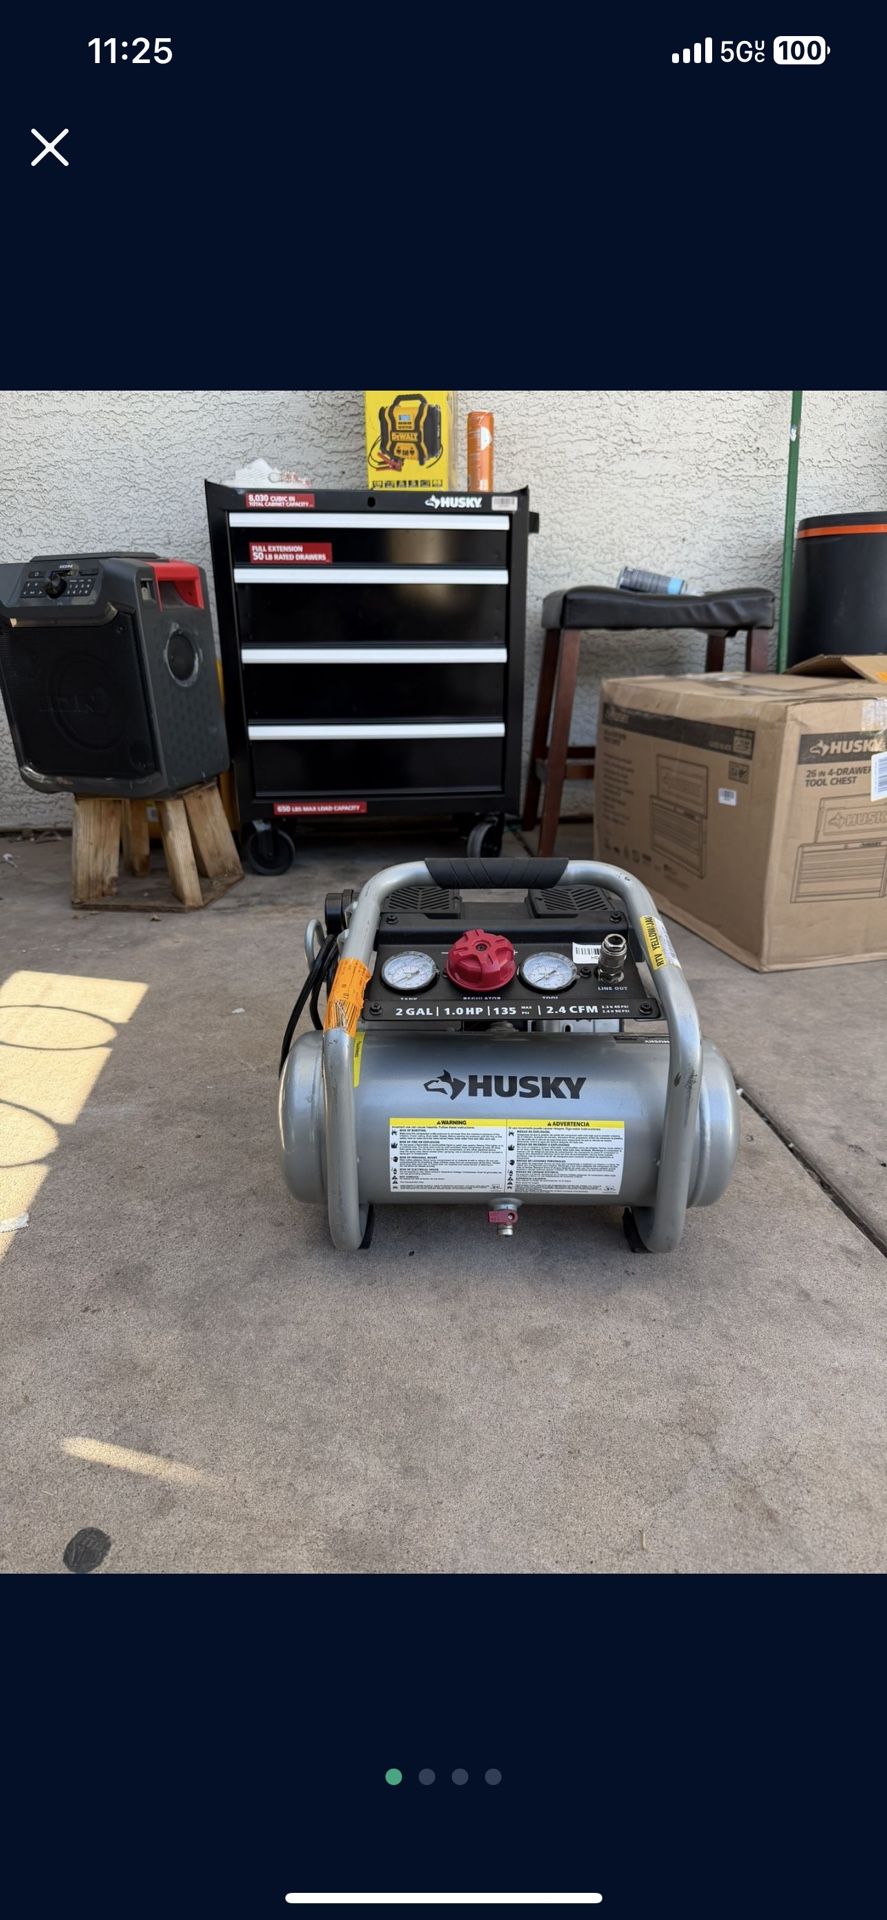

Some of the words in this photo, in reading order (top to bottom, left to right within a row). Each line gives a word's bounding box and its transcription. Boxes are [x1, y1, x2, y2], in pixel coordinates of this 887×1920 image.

[440, 496, 482, 509] HUSKY
[251, 545, 267, 553] FULL
[267, 545, 303, 553] EXTENSION
[252, 552, 264, 561] 50
[806, 769, 817, 779] 26
[818, 770, 826, 778] IN
[805, 778, 828, 788] TOOL
[829, 776, 857, 787] CHEST
[317, 804, 333, 812] LOAD
[333, 804, 361, 812] CAPACITY
[395, 1007, 403, 1016] 2
[405, 1007, 433, 1016] GAL
[443, 1006, 463, 1015] 1.0
[465, 1006, 484, 1015] HP
[493, 1006, 517, 1015] 135
[546, 1005, 567, 1014] 2.4
[569, 1005, 599, 1014] CFM
[468, 1074, 587, 1100] HUSKY
